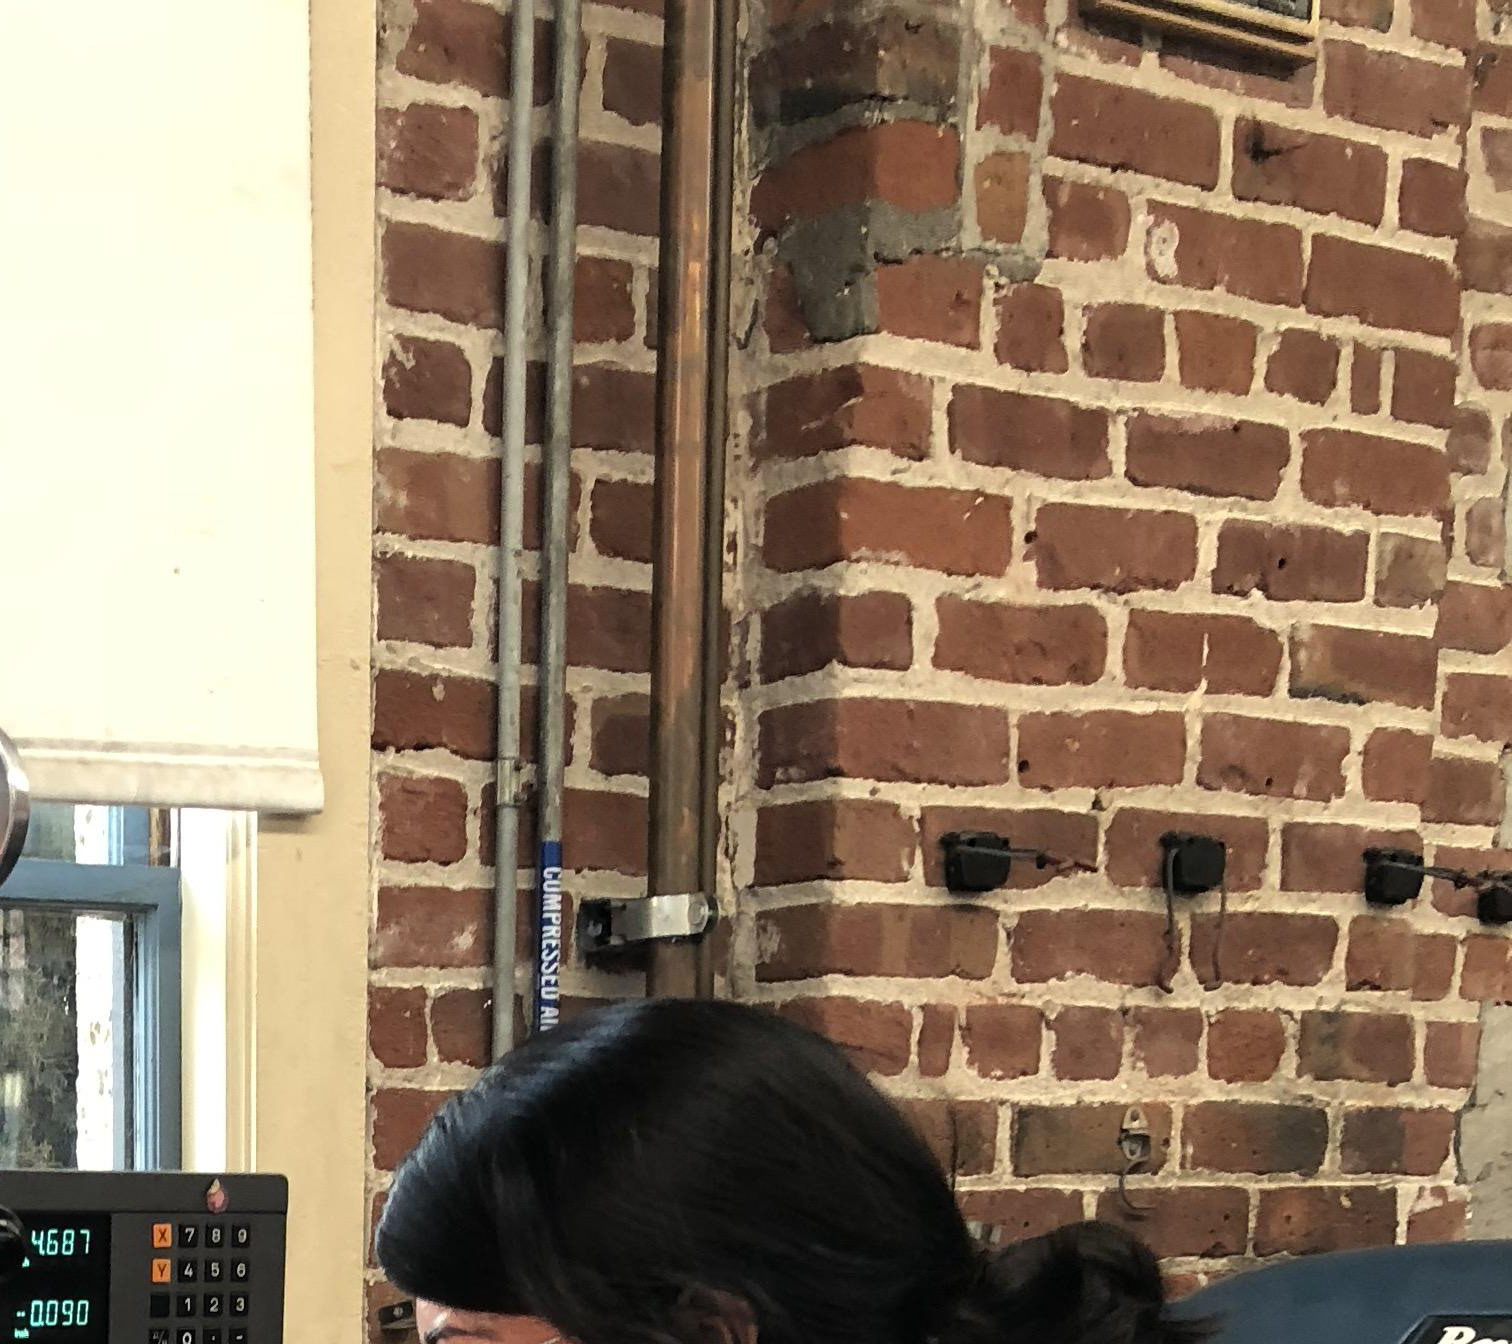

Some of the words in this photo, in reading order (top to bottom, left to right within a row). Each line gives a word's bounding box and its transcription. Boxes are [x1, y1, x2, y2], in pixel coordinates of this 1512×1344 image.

[541, 867, 562, 1001] COMPRESSED
[158, 1229, 167, 1243] X
[185, 1228, 195, 1242] 7
[211, 1228, 221, 1243] 8
[238, 1228, 247, 1243] 9
[158, 1263, 167, 1278] Y
[184, 1263, 193, 1277] 4
[211, 1262, 220, 1277] 5
[237, 1262, 246, 1277] 6
[210, 1297, 219, 1313] 2
[236, 1297, 245, 1312] 3
